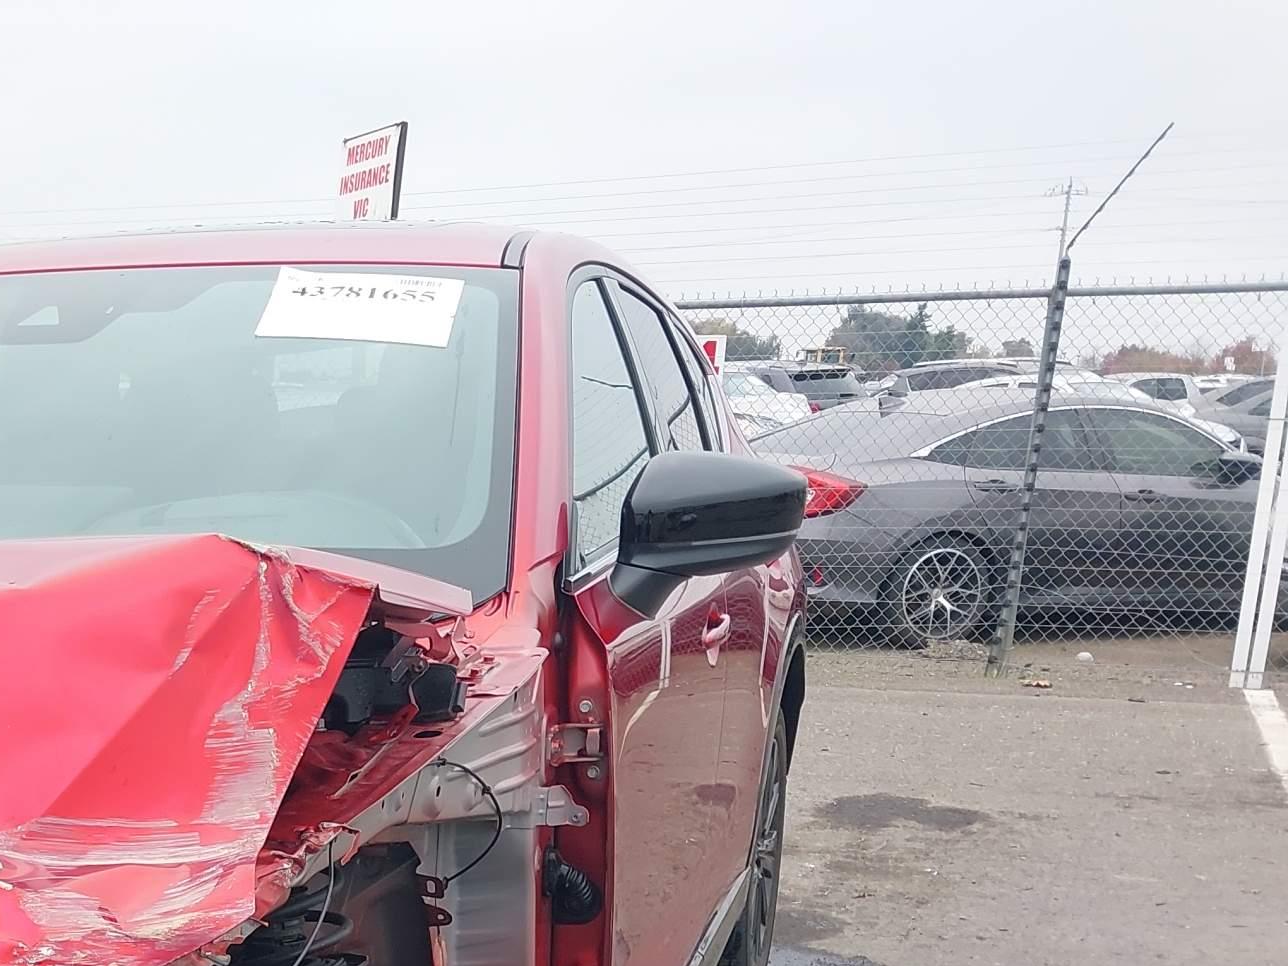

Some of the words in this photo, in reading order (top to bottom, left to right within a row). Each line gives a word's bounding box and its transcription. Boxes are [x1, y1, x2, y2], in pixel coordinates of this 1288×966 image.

[346, 134, 392, 167] MERCURY
[339, 163, 391, 197] INSURANCE
[352, 197, 369, 220] VIC
[291, 285, 437, 303] 43781655
